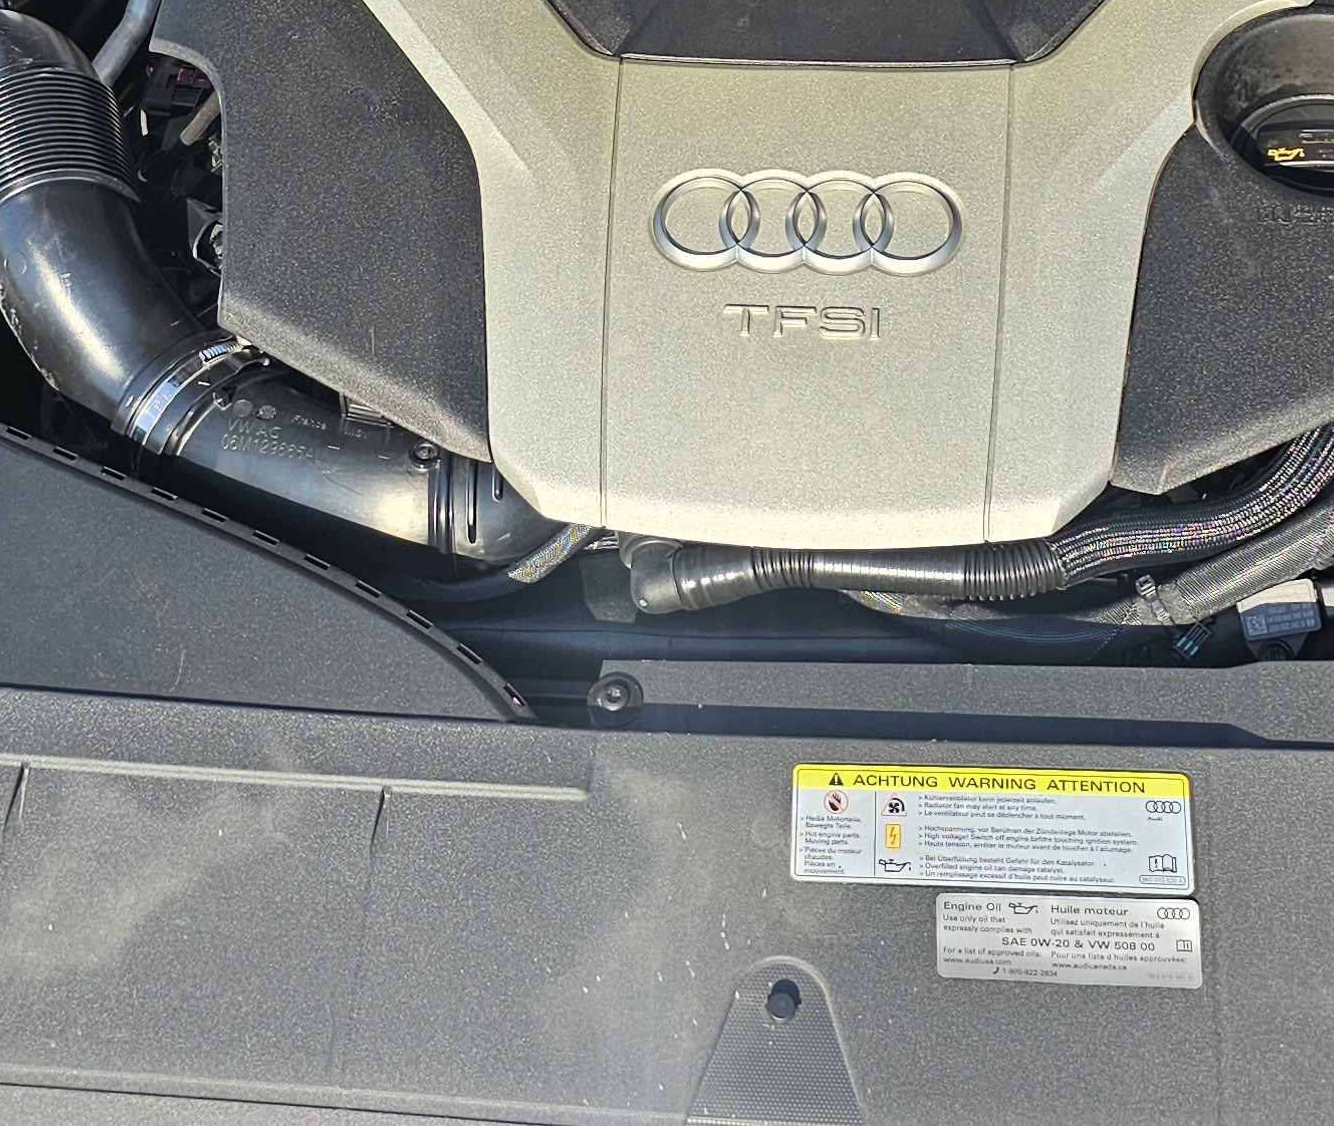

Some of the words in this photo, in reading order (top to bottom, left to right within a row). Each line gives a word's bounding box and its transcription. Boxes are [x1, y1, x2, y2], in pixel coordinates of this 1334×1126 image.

[723, 302, 883, 340] TFSI
[228, 418, 253, 432] VW
[255, 426, 282, 438] AG
[853, 774, 938, 788] ACHTUNG
[949, 776, 1037, 790] WARNING
[1046, 779, 1145, 793] ATTENTION
[943, 901, 982, 911] Engine
[986, 902, 1001, 911] Oil
[1051, 904, 1080, 914] Huile
[1084, 907, 1128, 916] moteur
[959, 914, 977, 923] only
[943, 925, 978, 933] expressly
[980, 925, 1014, 934] complies
[1080, 920, 1127, 929] uniquement
[1051, 928, 1063, 936] qui
[1065, 928, 1095, 936] satisfait
[1098, 929, 1153, 938] expressément
[1002, 937, 1026, 946] SAE
[1030, 938, 1069, 947] 0W-20
[1074, 940, 1084, 948] &
[1088, 941, 1110, 949] VW
[1115, 942, 1136, 950] 508
[1140, 942, 1155, 950] 00
[988, 948, 1024, 958] approved
[1051, 951, 1069, 959] Pour
[1088, 952, 1104, 960] liste
[943, 957, 1012, 965] www.audiusa.com
[1052, 962, 1127, 970] www.audicanada.ca
